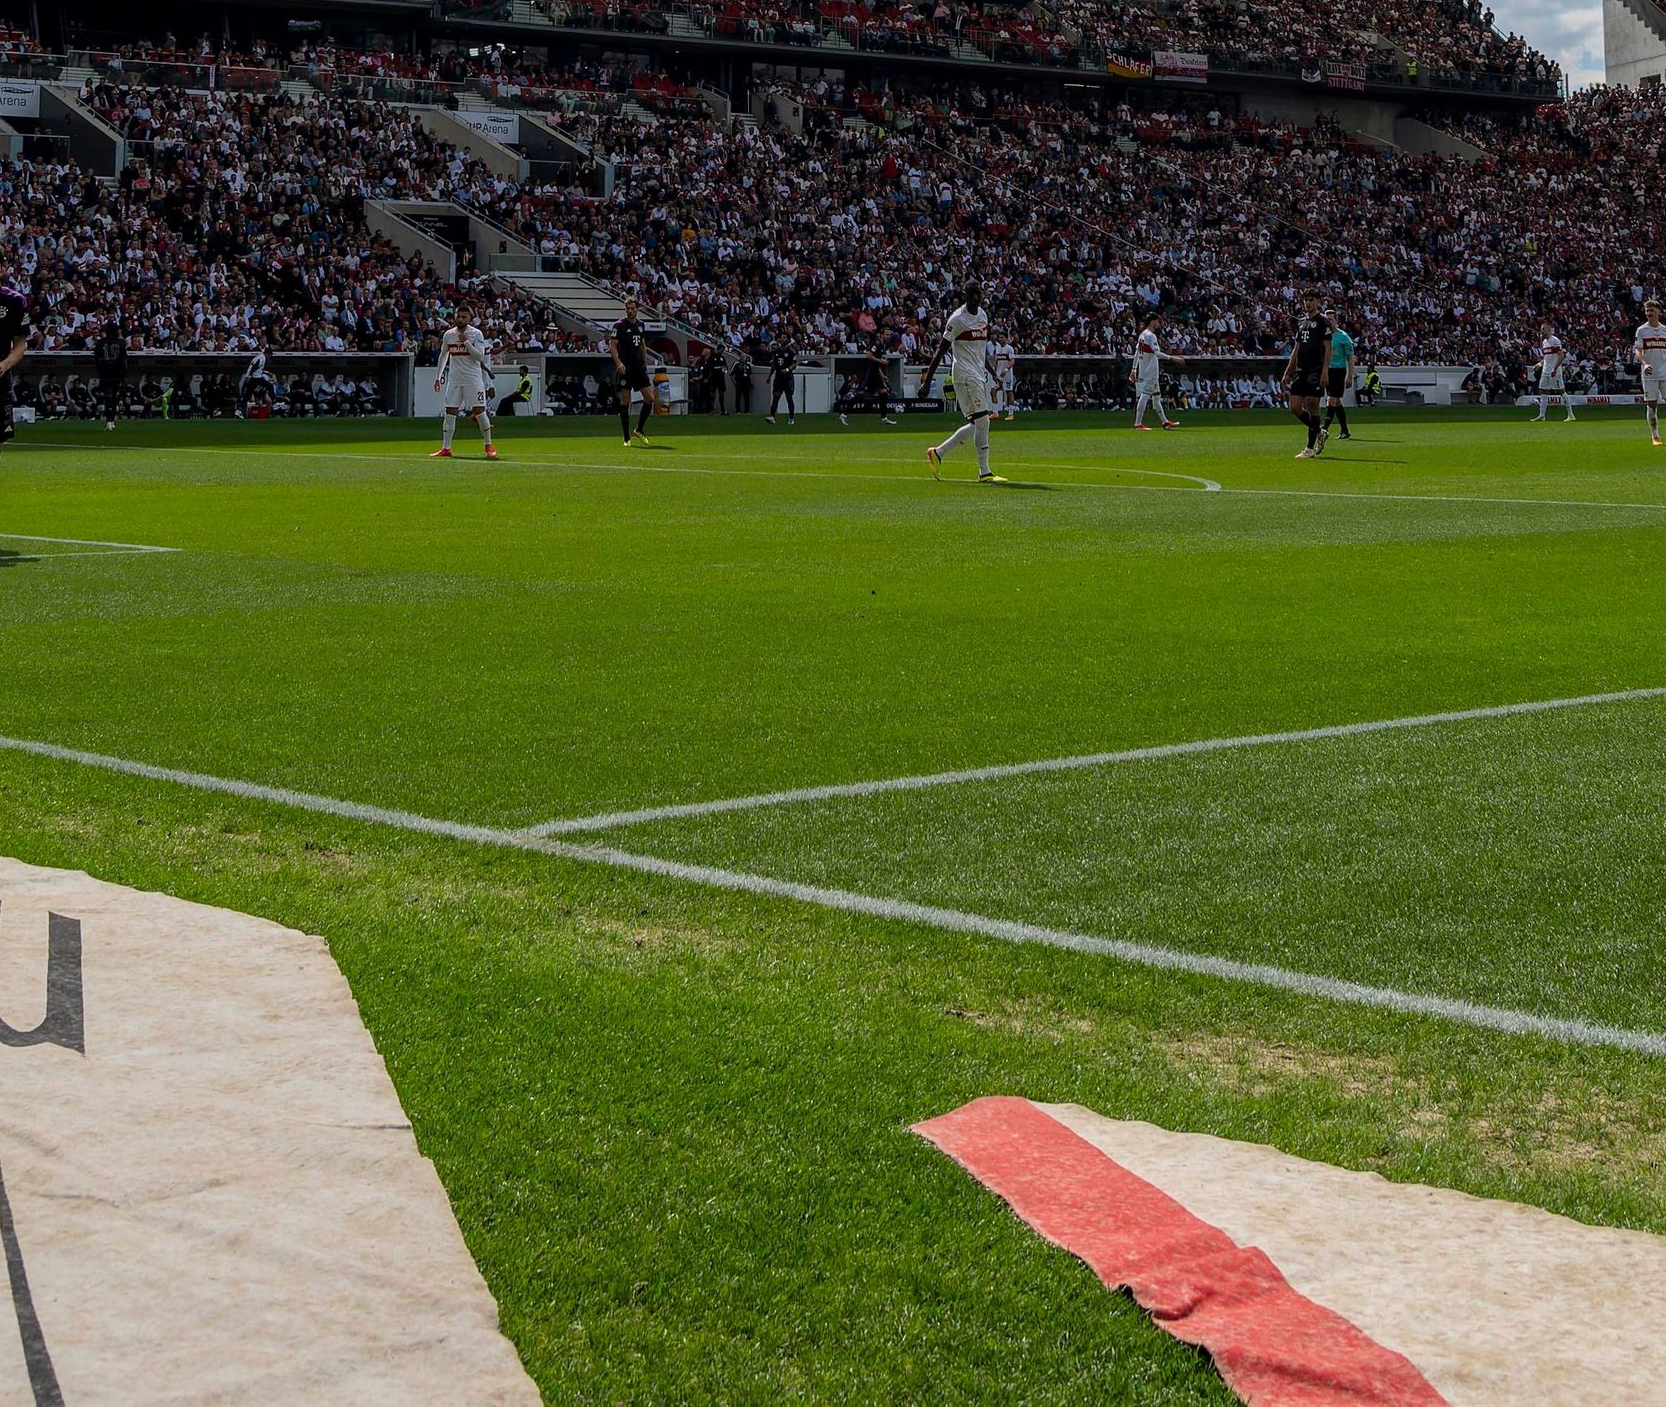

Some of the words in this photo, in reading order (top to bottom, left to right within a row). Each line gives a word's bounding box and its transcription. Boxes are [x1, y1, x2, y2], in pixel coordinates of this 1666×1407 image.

[1327, 76, 1365, 92] STUTTGART
[482, 122, 509, 134] Arena
[100, 343, 120, 360] 19
